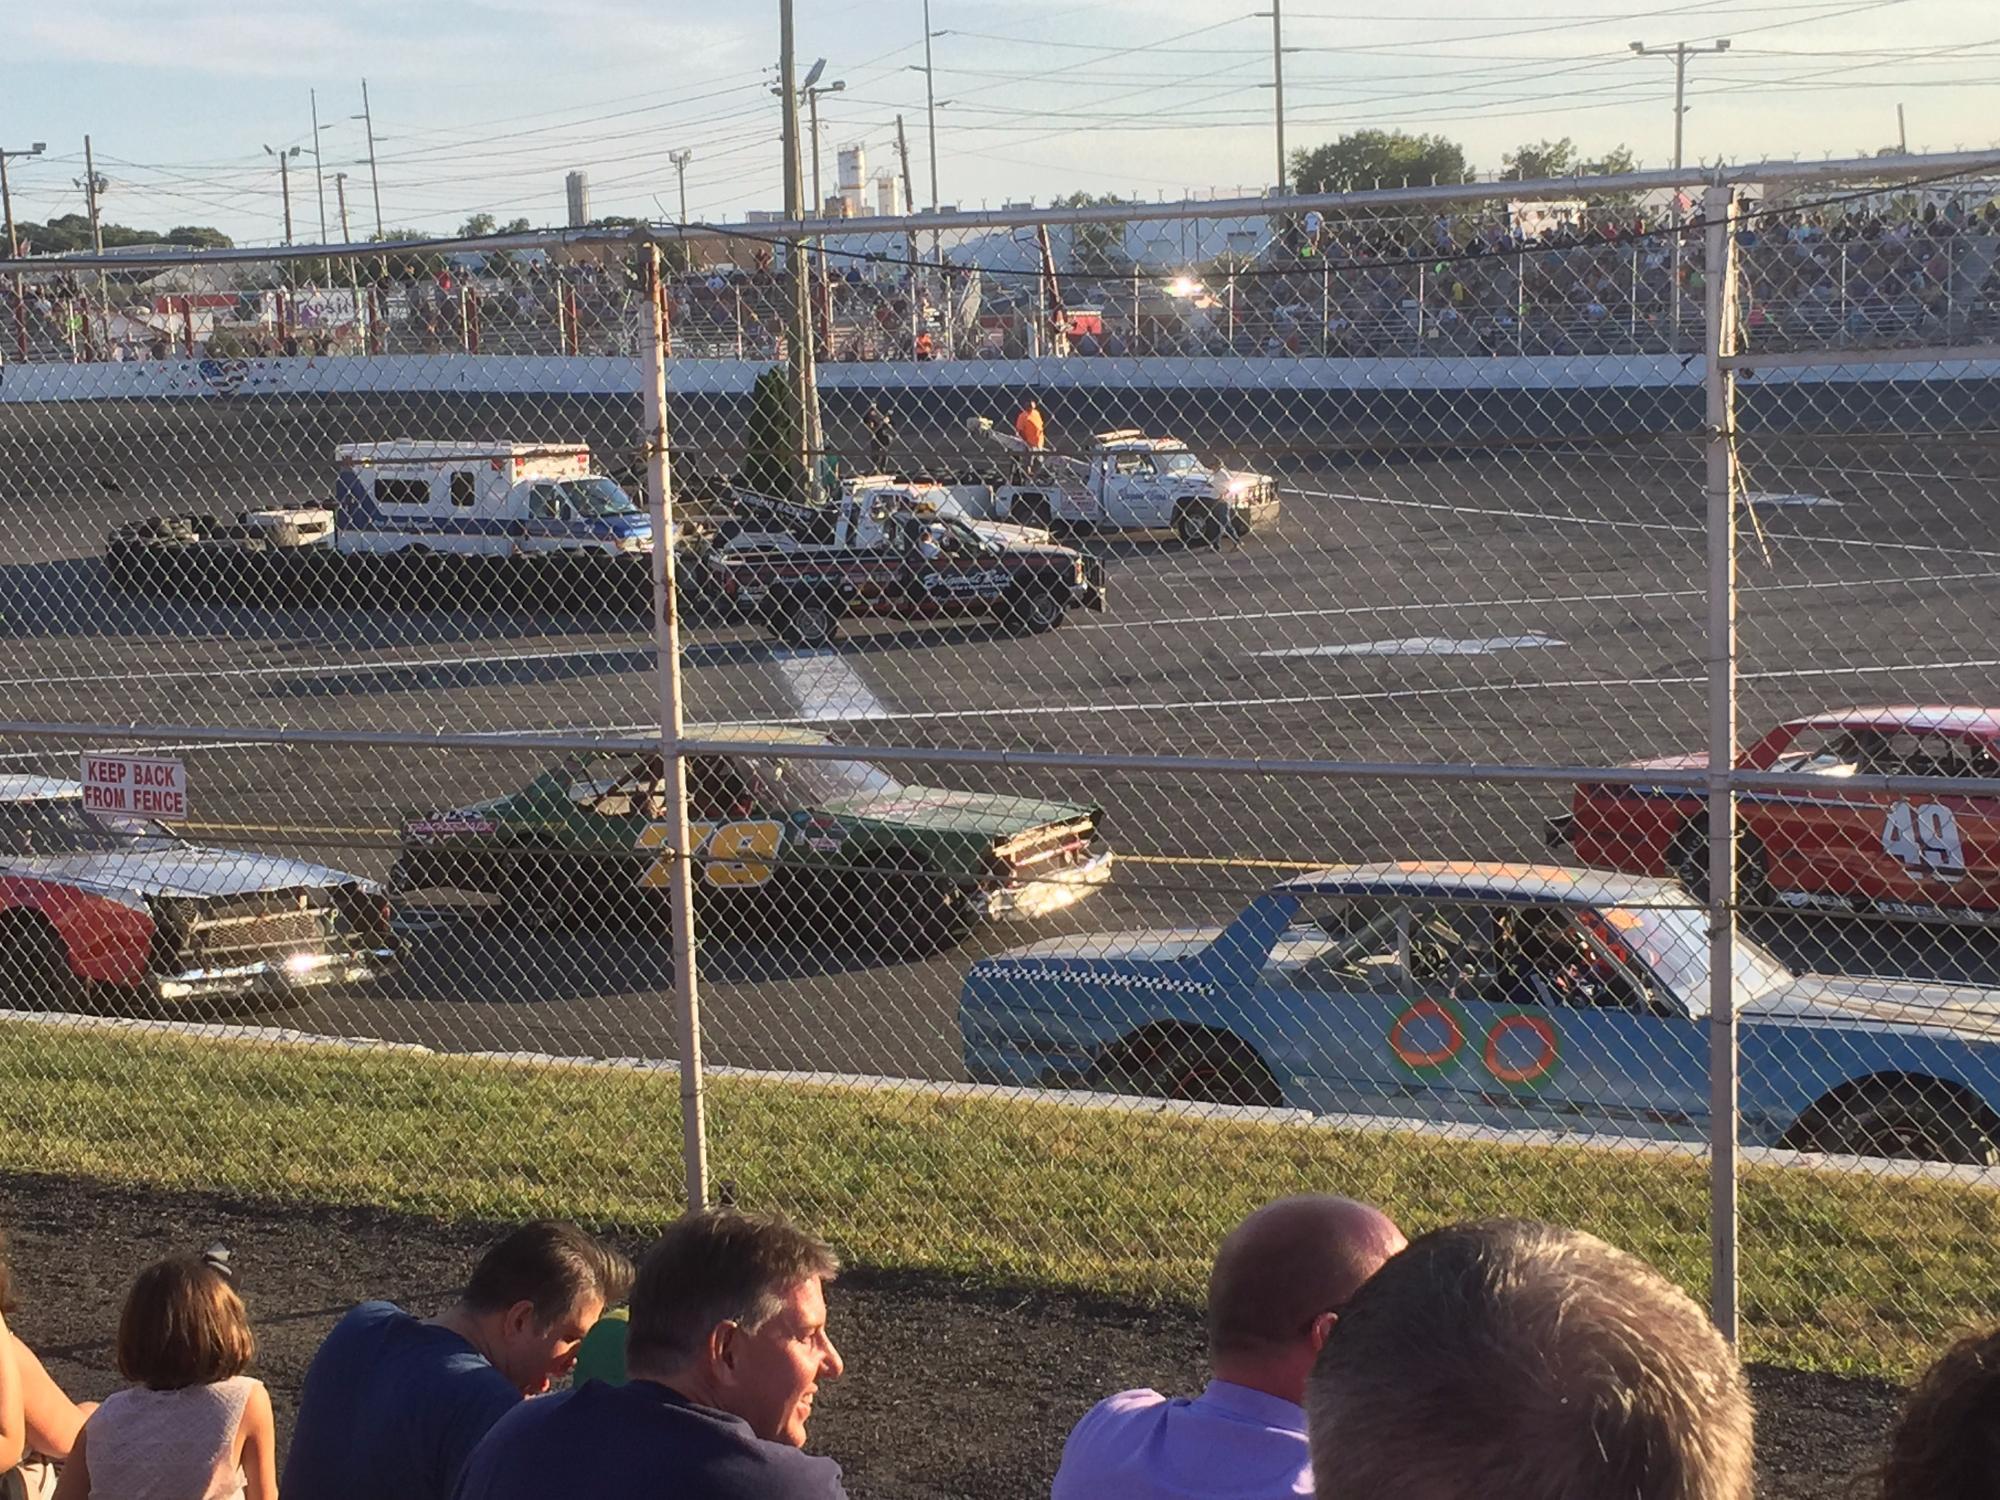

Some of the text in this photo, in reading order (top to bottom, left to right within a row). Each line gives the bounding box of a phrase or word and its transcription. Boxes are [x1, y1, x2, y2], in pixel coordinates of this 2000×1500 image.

[88, 761, 176, 787] KEEP BACK
[84, 785, 183, 813] FROM FENCE
[1882, 801, 1965, 882] 49
